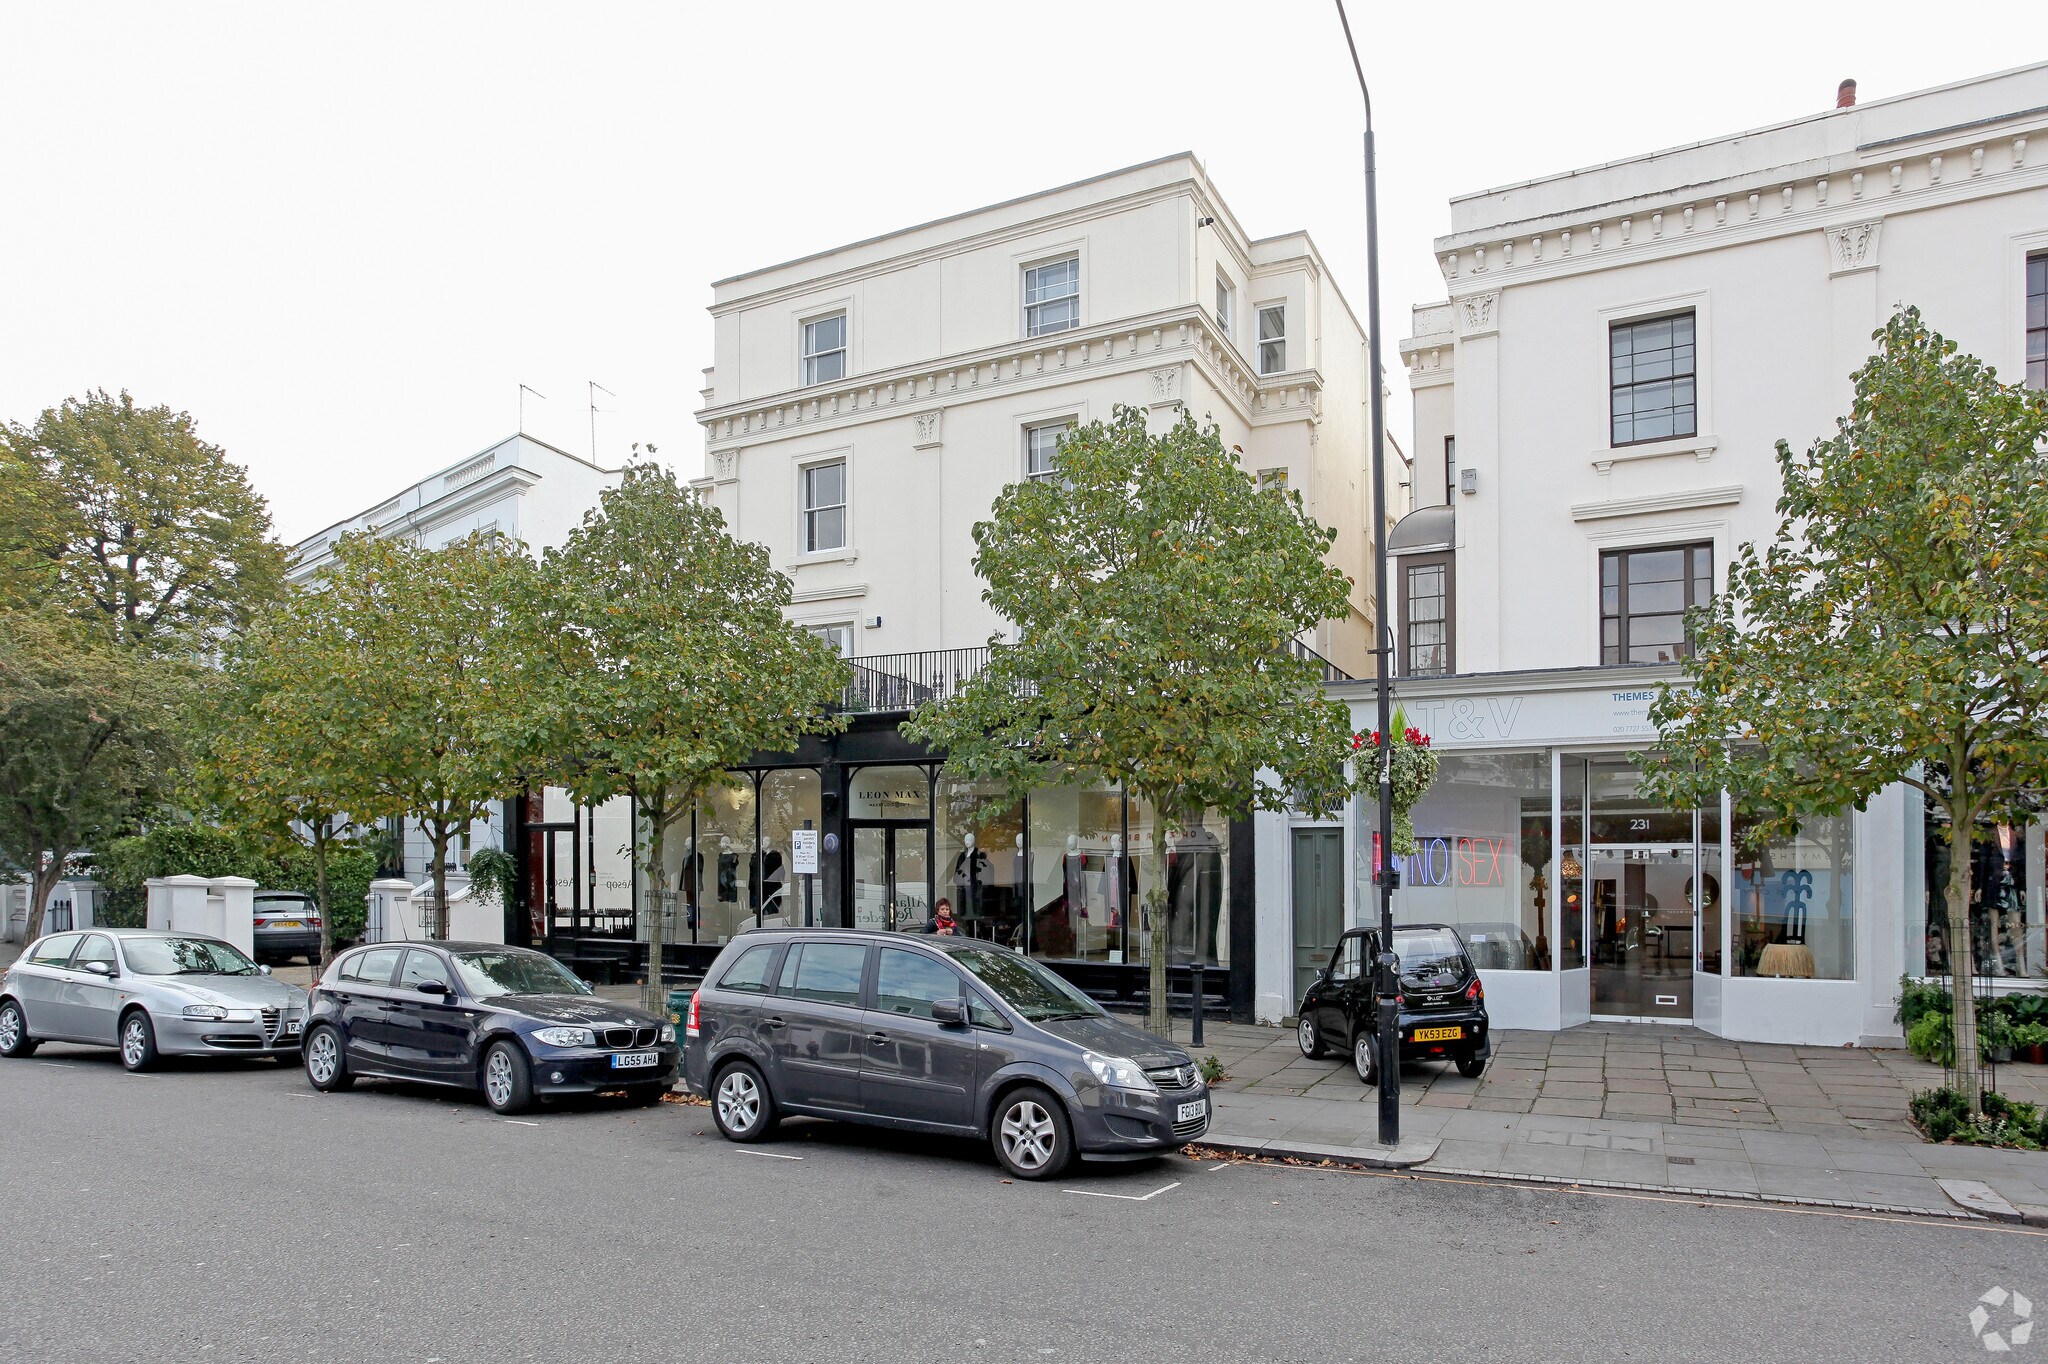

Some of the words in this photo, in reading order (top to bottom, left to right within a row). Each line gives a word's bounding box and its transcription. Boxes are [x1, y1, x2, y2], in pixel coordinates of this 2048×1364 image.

[1612, 691, 1654, 702] THEMES
[859, 791, 890, 799] LEON
[895, 790, 920, 798] MAX
[1630, 818, 1650, 830] 231
[1410, 838, 1448, 885] NO
[1459, 838, 1503, 885] SEX
[1419, 1030, 1440, 1040] YK53
[1442, 1028, 1458, 1038] EZG
[618, 1056, 641, 1066] LG55
[643, 1054, 658, 1065] AHA
